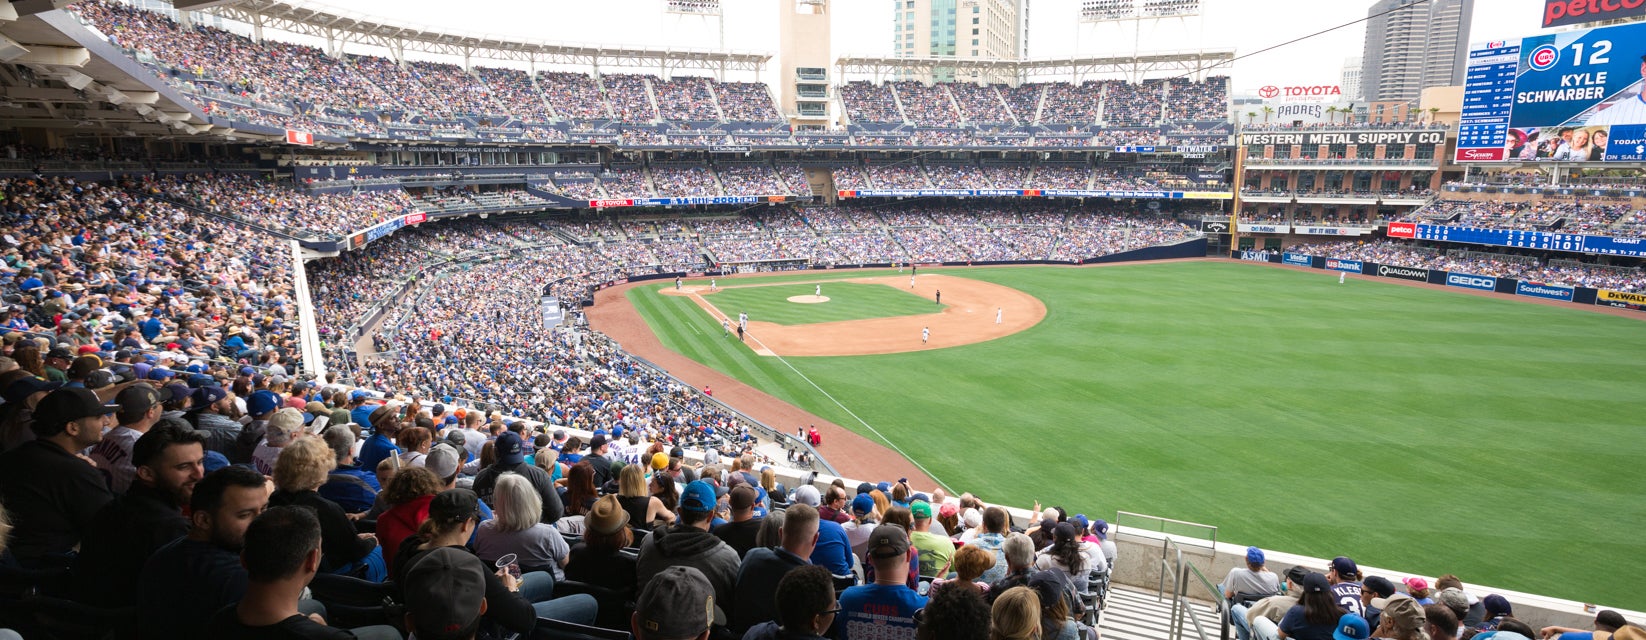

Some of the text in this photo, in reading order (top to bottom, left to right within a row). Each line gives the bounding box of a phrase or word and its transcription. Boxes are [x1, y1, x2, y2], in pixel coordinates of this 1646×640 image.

[1571, 40, 1612, 66] 12
[1560, 71, 1608, 87] KYLE
[1284, 85, 1341, 96] TOYOTA
[1517, 87, 1605, 104] SCHWARBER
[1278, 104, 1321, 118] PADRES
[1243, 132, 1444, 144] WESTERN METAL SUPPLY CO.
[1613, 237, 1640, 245] COSART
[1241, 251, 1268, 262] ASML
[1380, 265, 1426, 278] QUALCOMM
[1449, 275, 1494, 287] GEICO
[1520, 285, 1563, 296] Southwest
[625, 454, 638, 464] 44
[863, 603, 898, 616] CUBS
